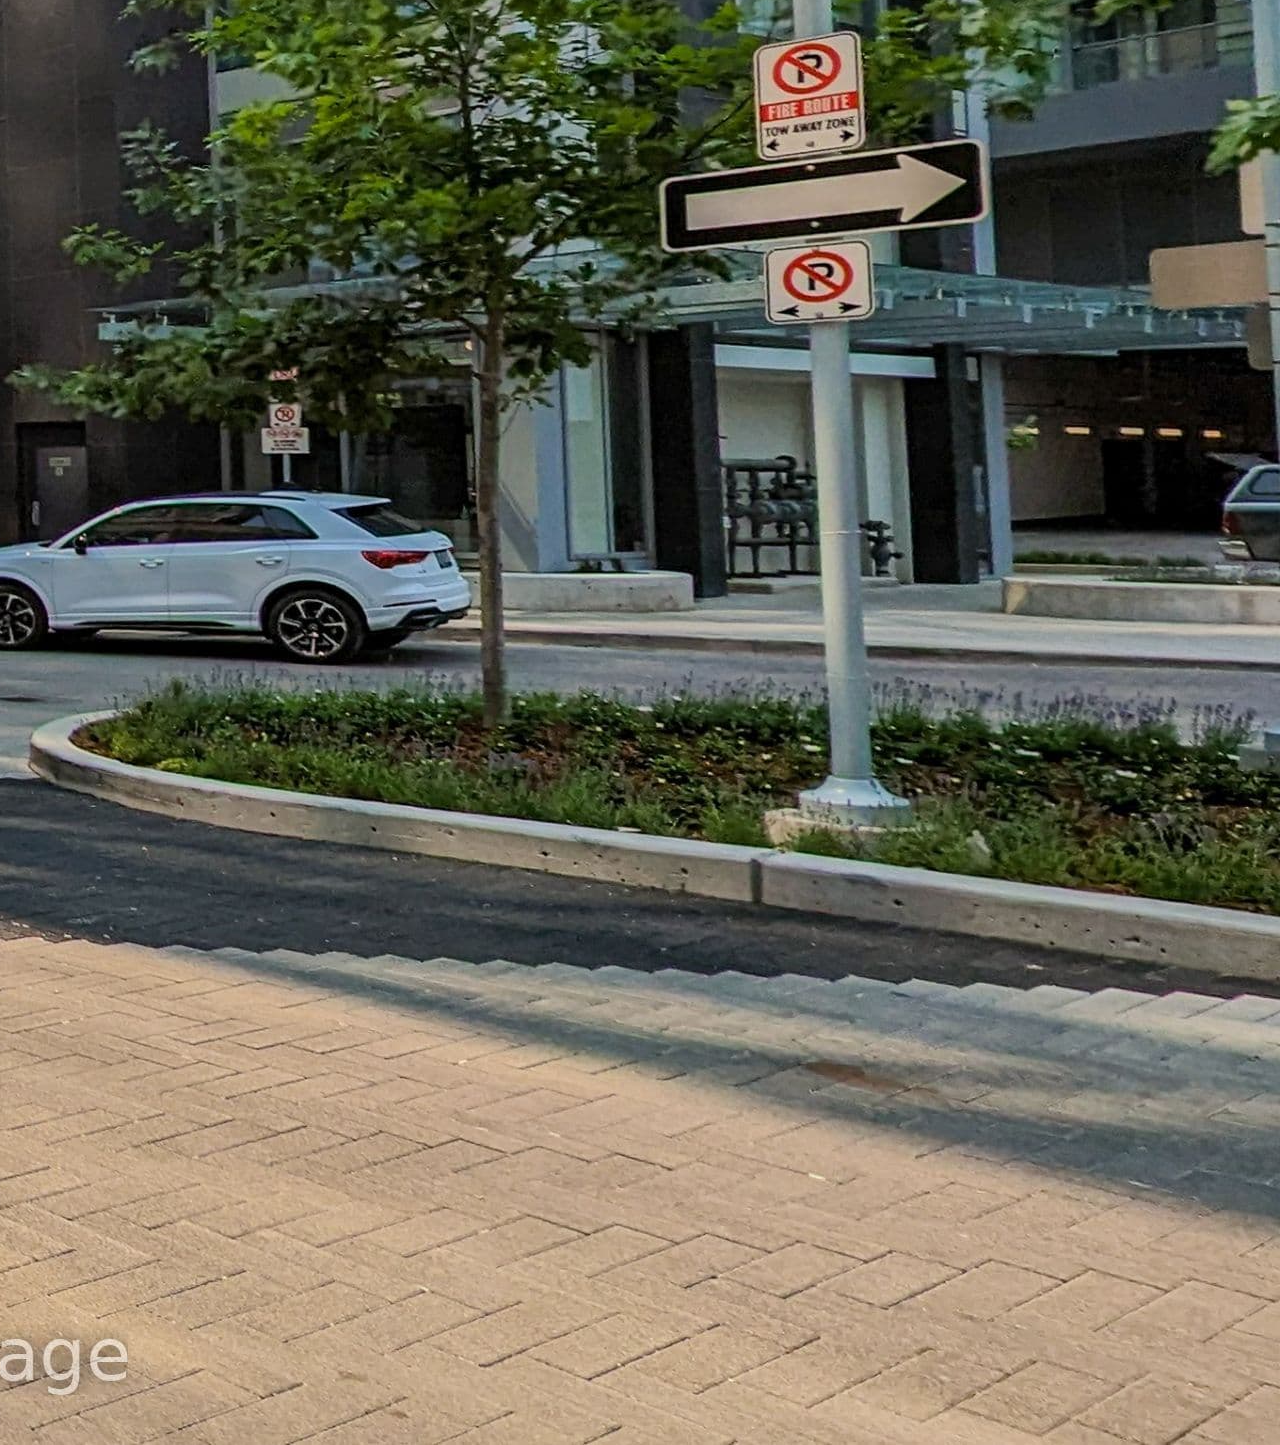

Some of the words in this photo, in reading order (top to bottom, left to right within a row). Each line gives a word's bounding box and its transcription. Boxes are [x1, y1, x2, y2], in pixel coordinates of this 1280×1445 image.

[768, 101, 799, 120] FIRE
[803, 95, 850, 115] ROUTE
[765, 125, 790, 137] TOW
[792, 120, 823, 133] AWAY
[825, 116, 856, 129] ZONE
